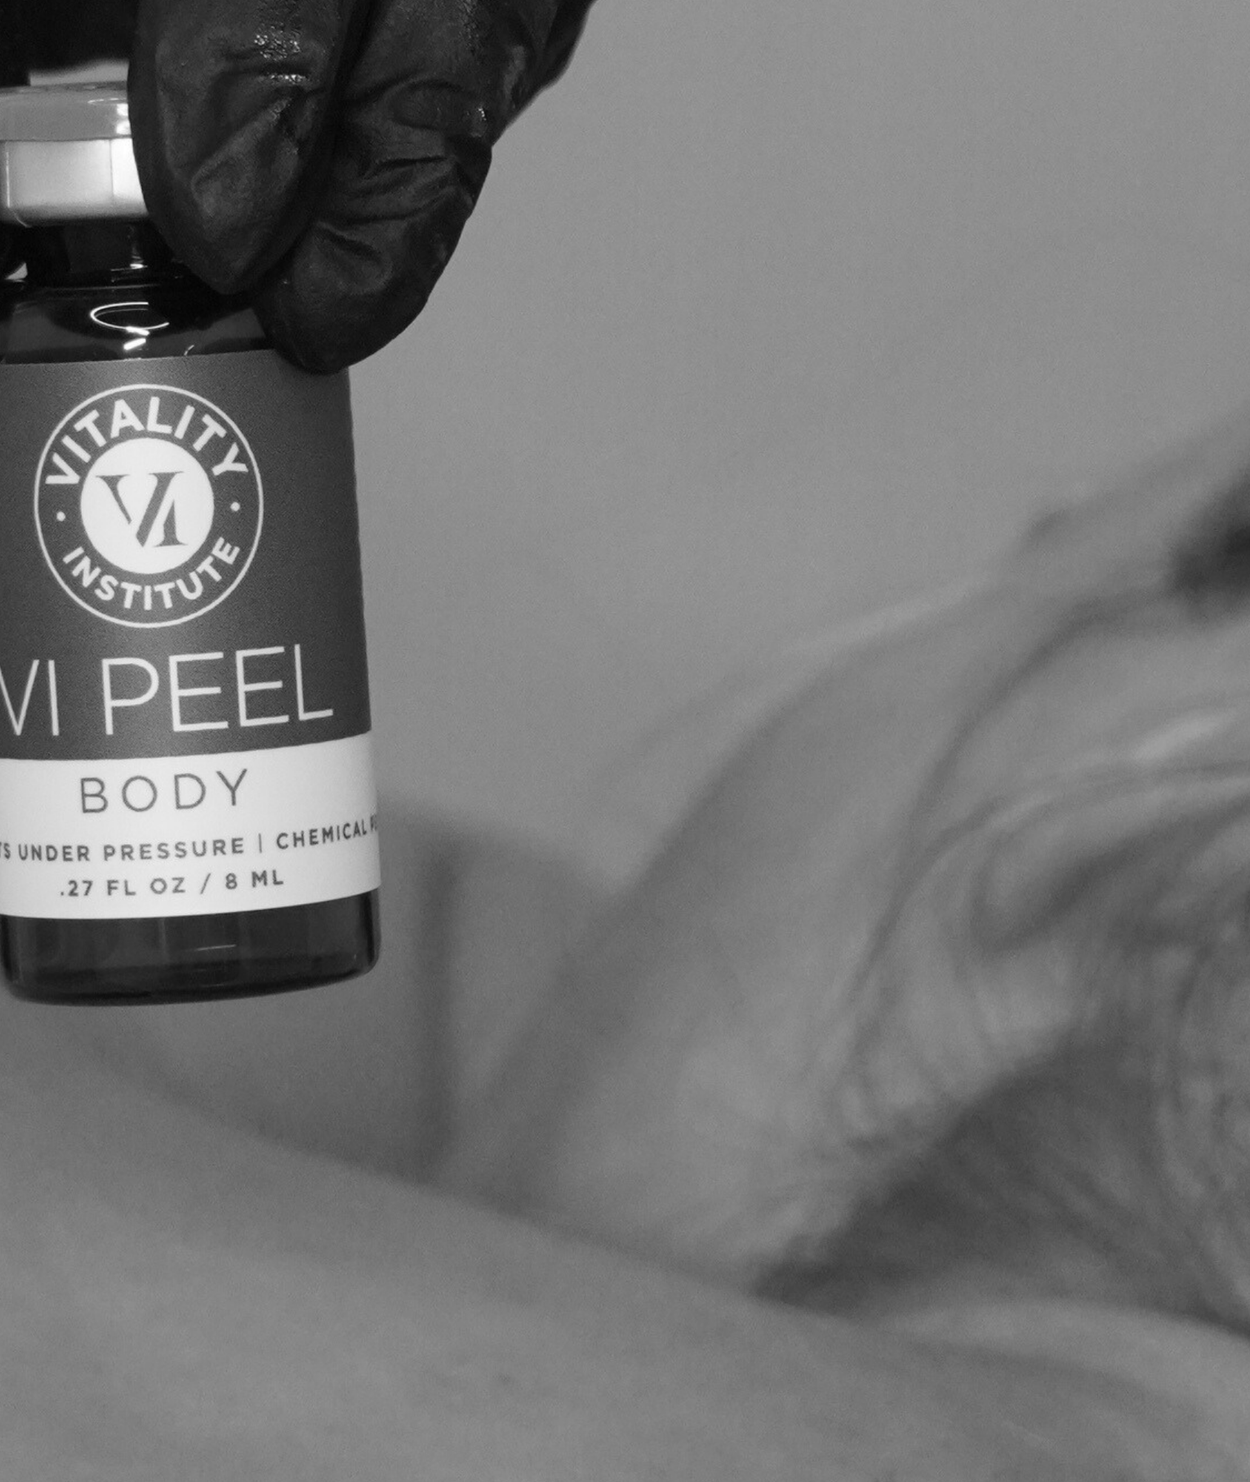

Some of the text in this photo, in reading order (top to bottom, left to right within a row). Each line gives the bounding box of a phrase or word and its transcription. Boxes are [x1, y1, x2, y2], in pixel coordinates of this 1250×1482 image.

[45, 397, 249, 484] VITALITY
[63, 537, 240, 610] INSTITUTE
[102, 644, 334, 735] PEEL
[80, 769, 248, 814] BODY
[18, 844, 91, 863] UNDER
[103, 837, 245, 863] PRESSURE
[276, 818, 368, 850] CHEMICAL
[60, 869, 284, 898] .27 FL OZ / 8 ML
